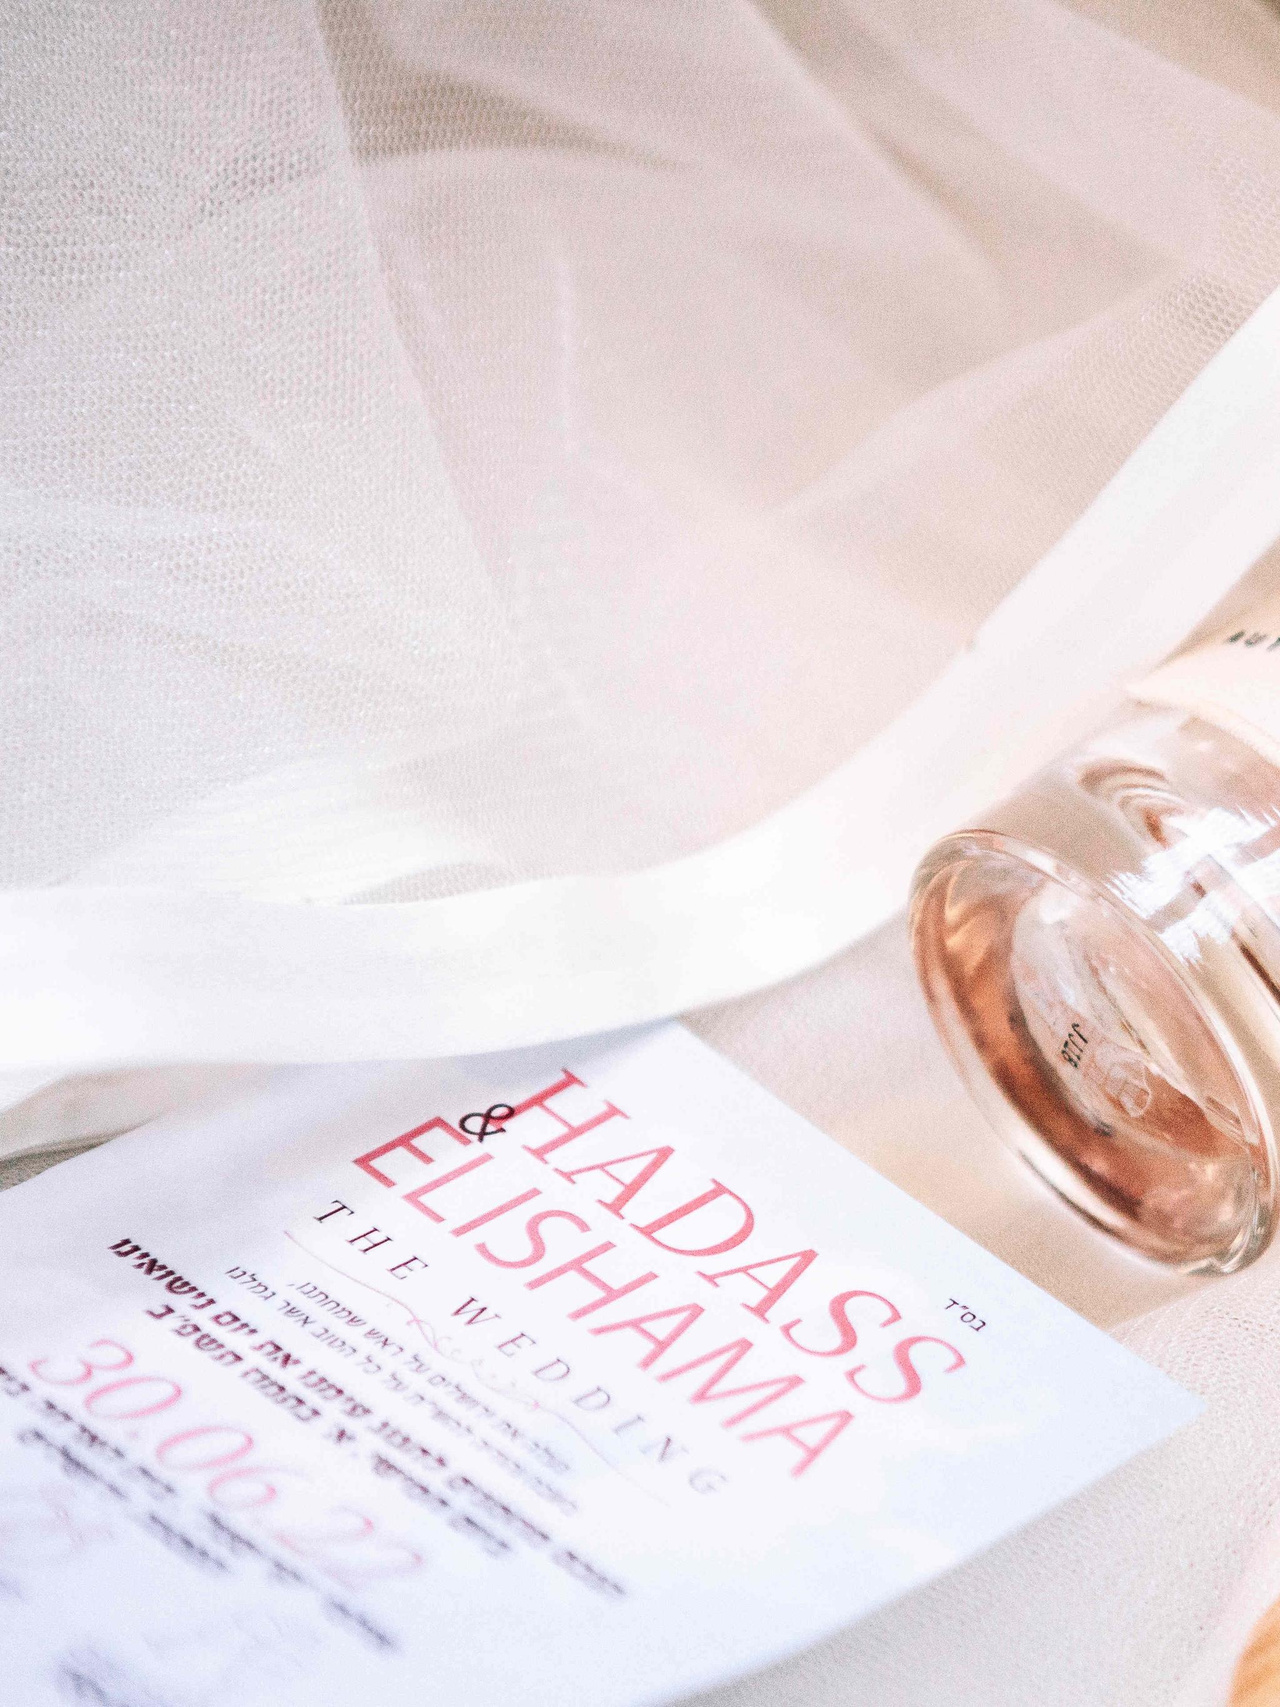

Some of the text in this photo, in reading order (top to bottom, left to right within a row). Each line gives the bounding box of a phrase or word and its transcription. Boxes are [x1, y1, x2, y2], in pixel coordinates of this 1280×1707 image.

[458, 1102, 516, 1143] &
[487, 1067, 967, 1405] HADASS
[106, 1237, 218, 1311] נישואינו
[223, 1265, 277, 1301] גמלנו
[276, 1299, 318, 1328] אשר
[351, 1115, 855, 1480] ELISHAMA
[209, 1309, 259, 1337] יום
[249, 1338, 303, 1370] את
[310, 1326, 359, 1358] הטוב
[312, 1199, 429, 1281] THE
[450, 1296, 729, 1495] WEDDING
[363, 1327, 405, 1357] ראש
